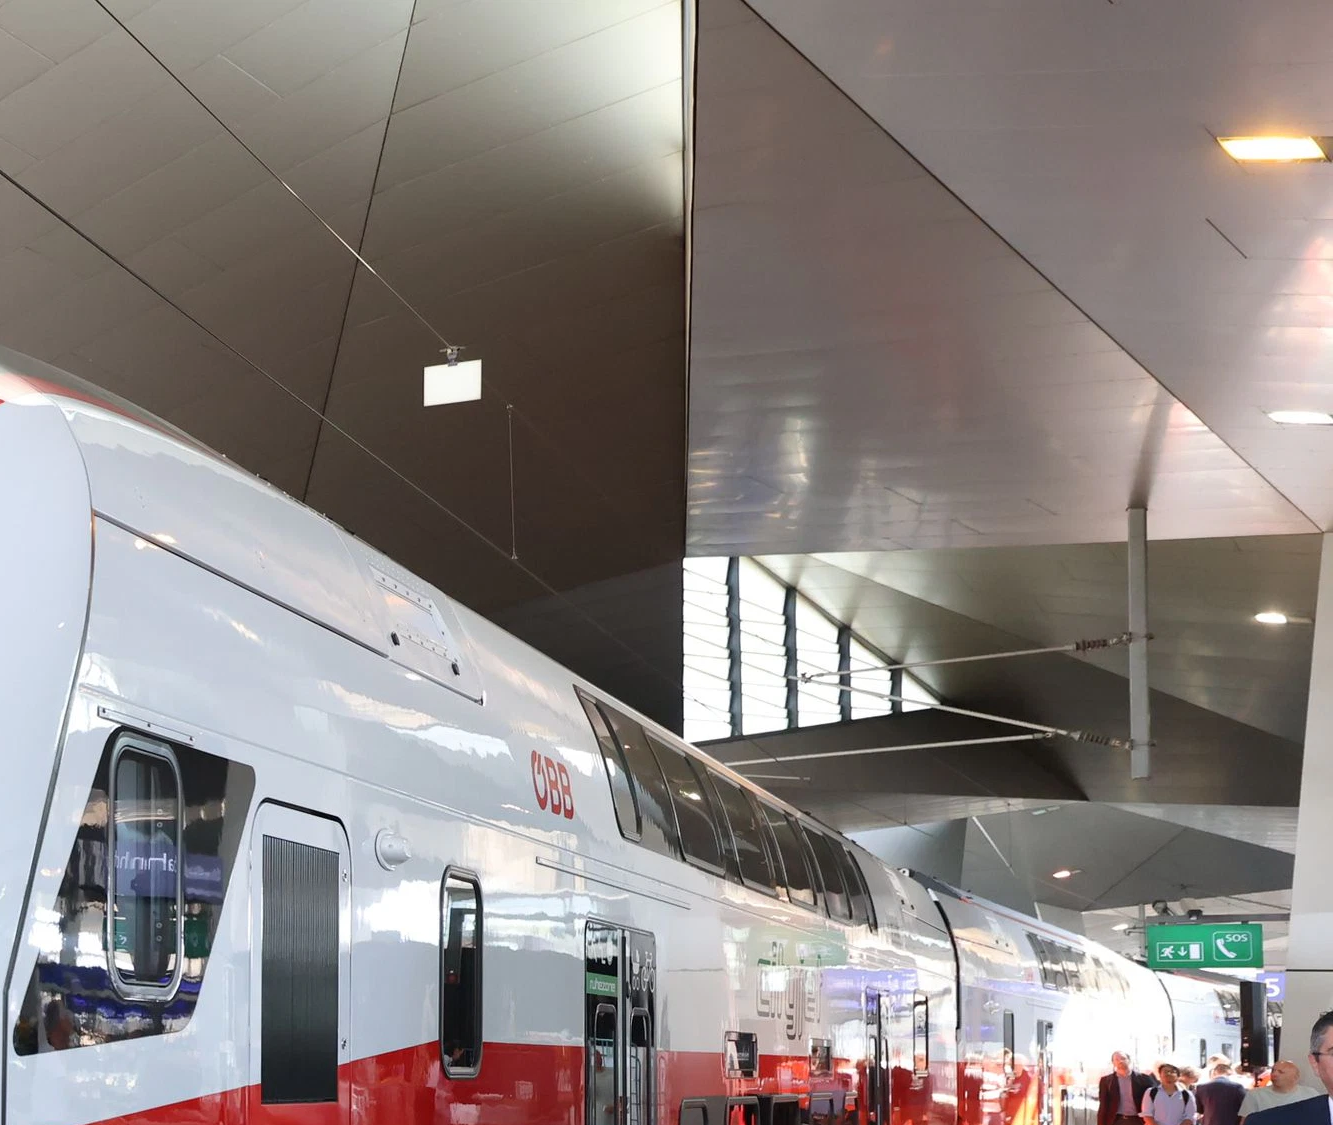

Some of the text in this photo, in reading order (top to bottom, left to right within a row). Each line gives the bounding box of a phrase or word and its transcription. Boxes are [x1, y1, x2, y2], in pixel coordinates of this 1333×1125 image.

[531, 750, 574, 820] ÖBB
[1225, 933, 1248, 943] SOS
[1266, 978, 1280, 998] 5
